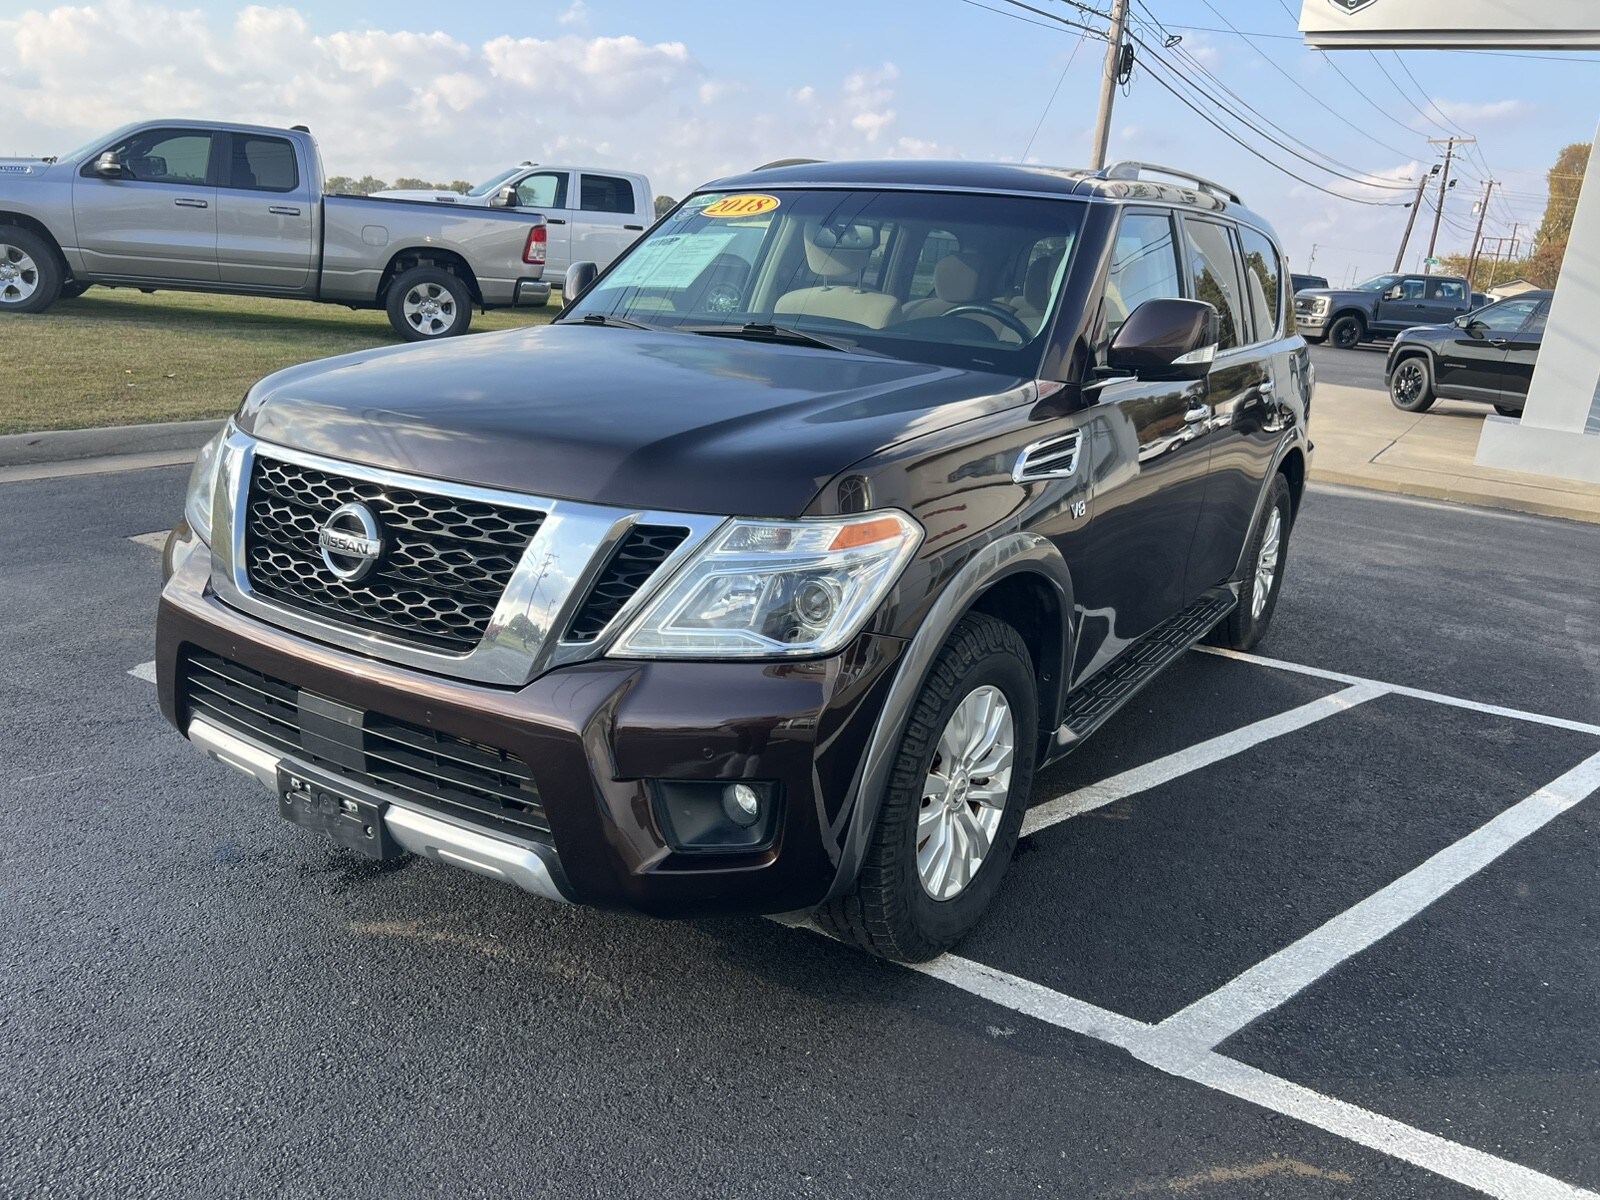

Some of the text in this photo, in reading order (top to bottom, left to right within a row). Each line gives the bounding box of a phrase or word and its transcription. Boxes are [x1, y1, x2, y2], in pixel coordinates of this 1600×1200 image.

[706, 198, 771, 213] 2018
[1070, 500, 1086, 519] V8
[320, 531, 369, 555] NISSAN
